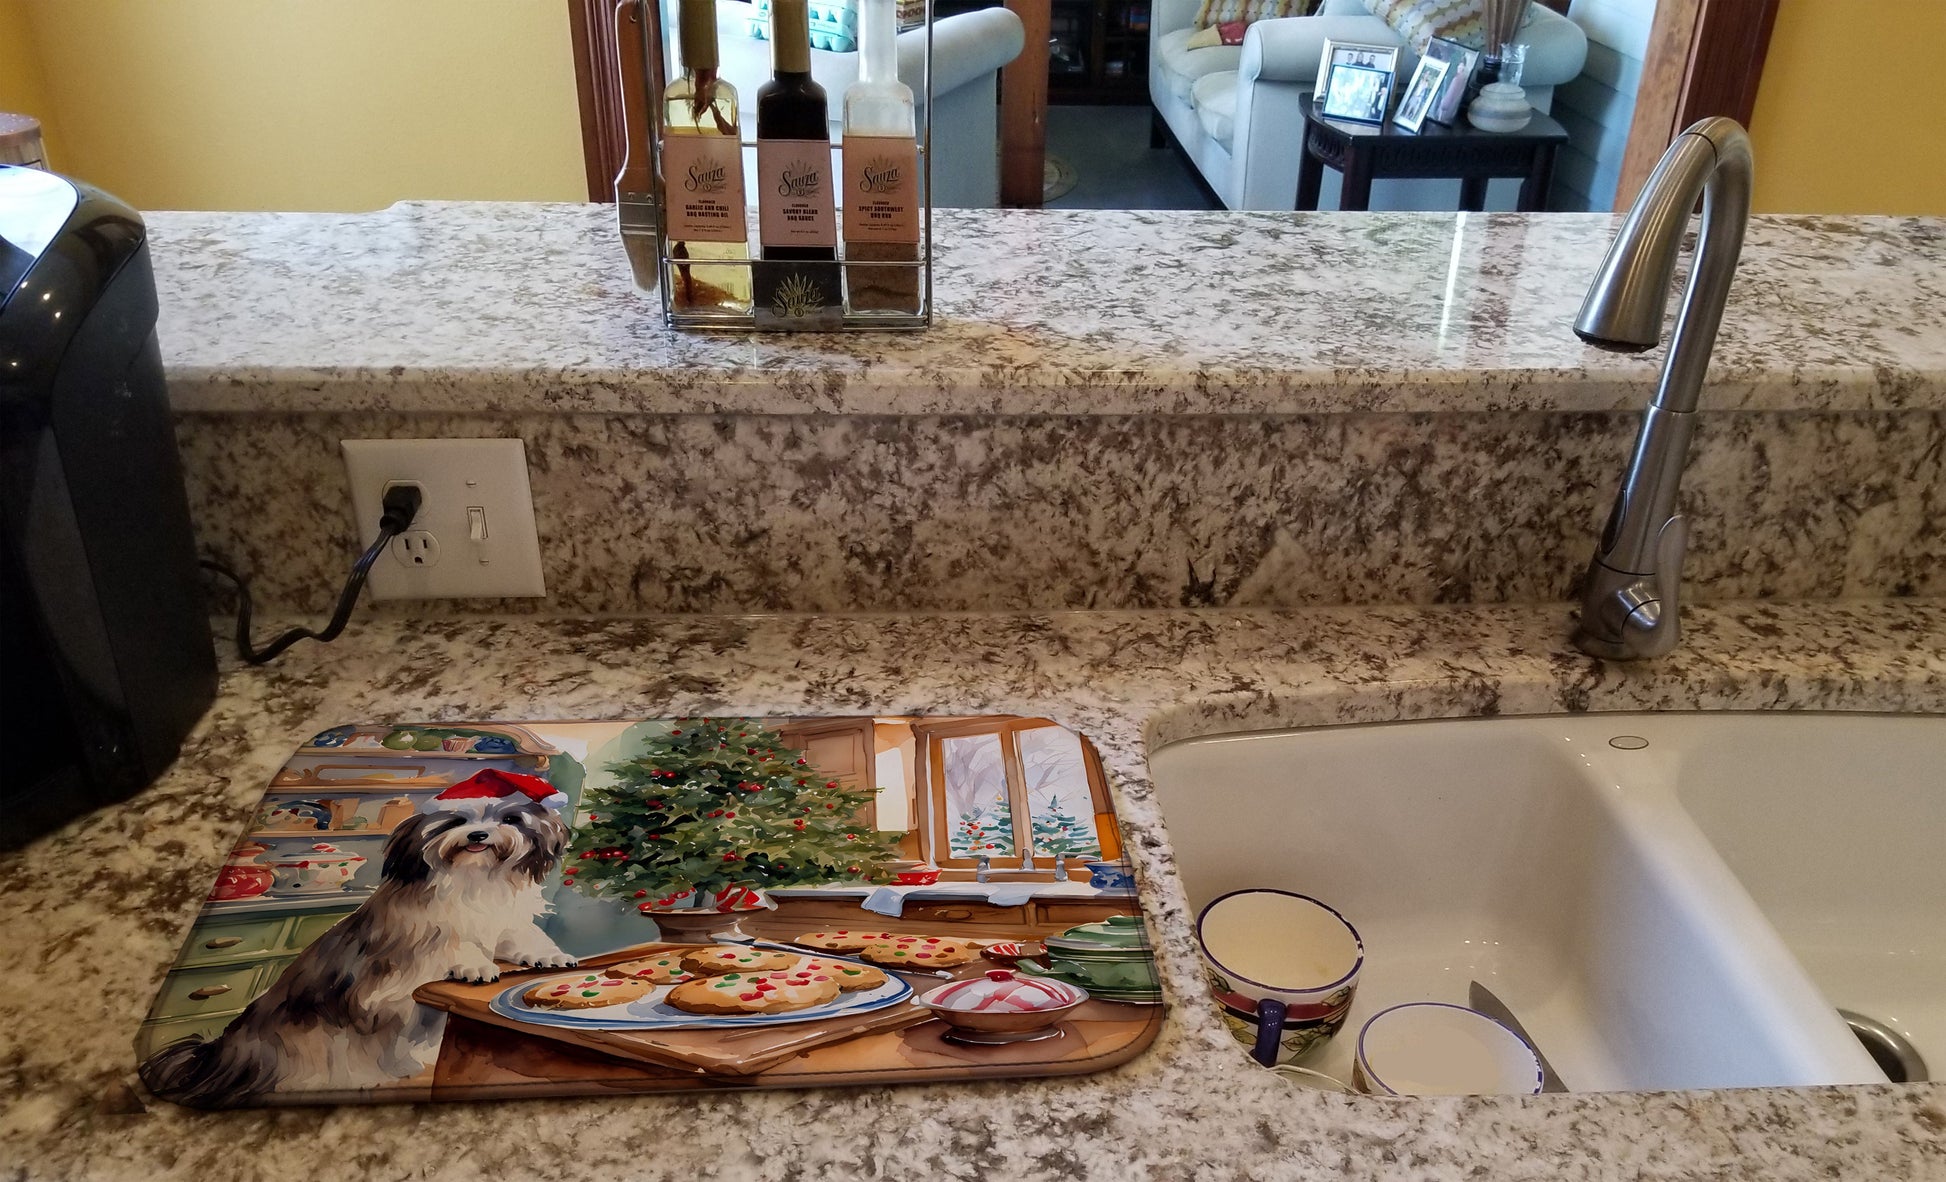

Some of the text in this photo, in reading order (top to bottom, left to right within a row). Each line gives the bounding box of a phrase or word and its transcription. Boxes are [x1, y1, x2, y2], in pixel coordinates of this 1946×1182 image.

[685, 166, 725, 192] Sauza
[779, 171, 819, 197] Sauza
[860, 166, 899, 192] Sauza
